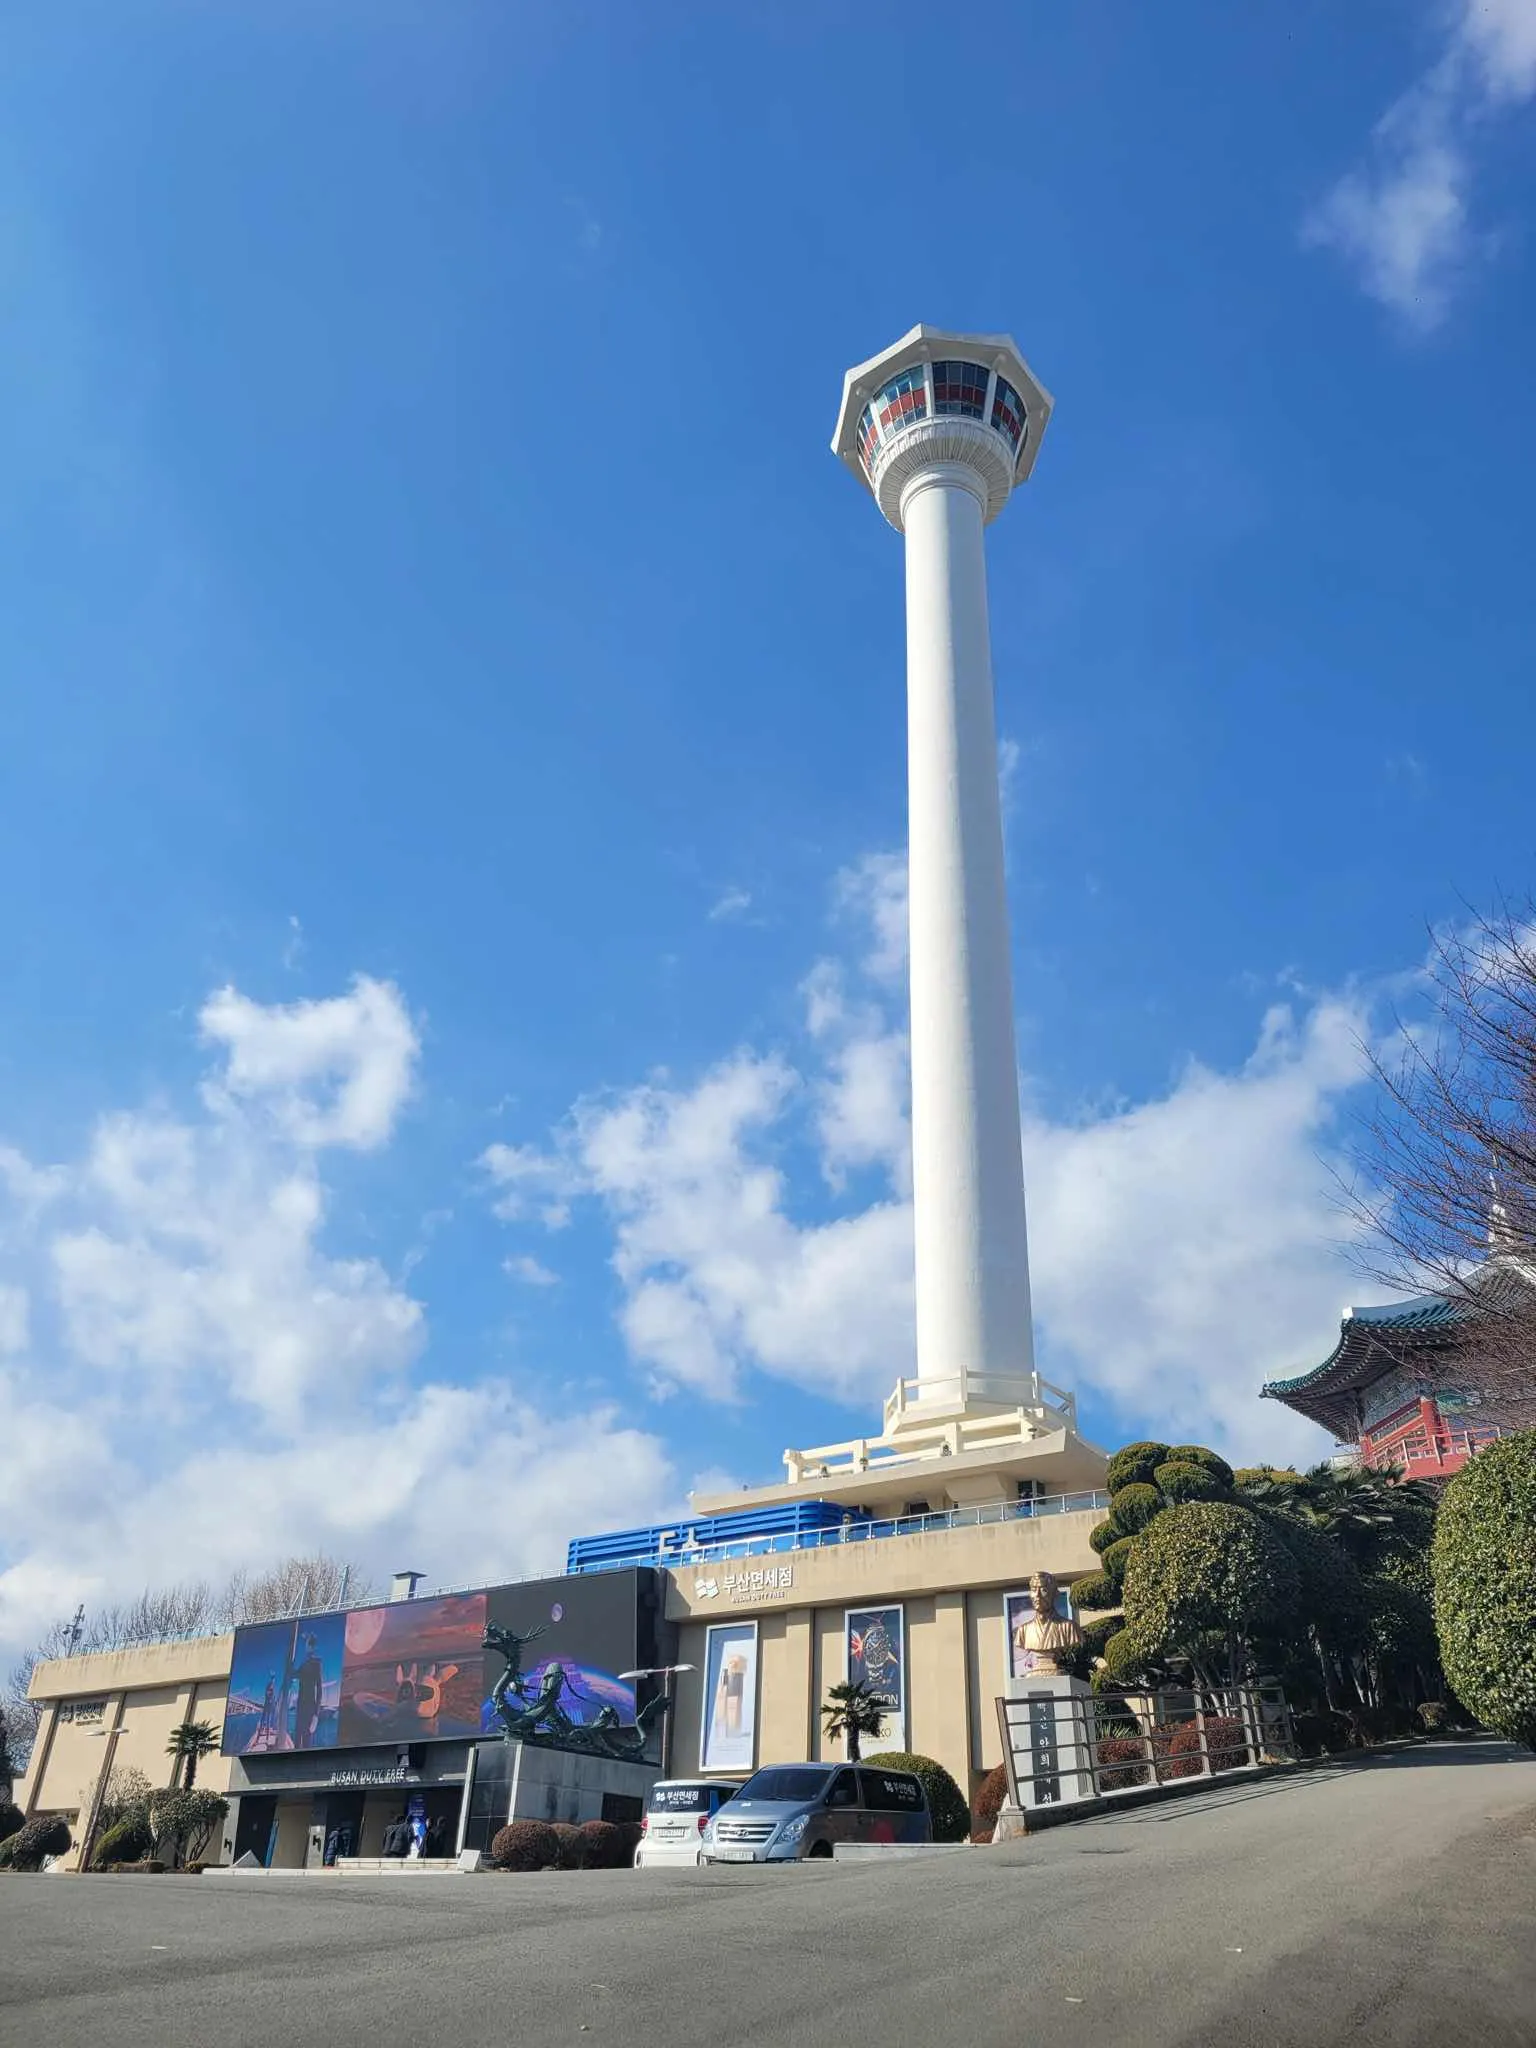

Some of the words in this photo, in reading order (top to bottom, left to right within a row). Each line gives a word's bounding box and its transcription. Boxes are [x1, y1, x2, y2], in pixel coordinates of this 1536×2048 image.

[723, 1566, 792, 1594] 부산면세점
[331, 1771, 358, 1784] BUSAN
[360, 1769, 383, 1782] DUTY
[386, 1767, 405, 1780] FREE
[667, 1791, 699, 1801] 부산면세점
